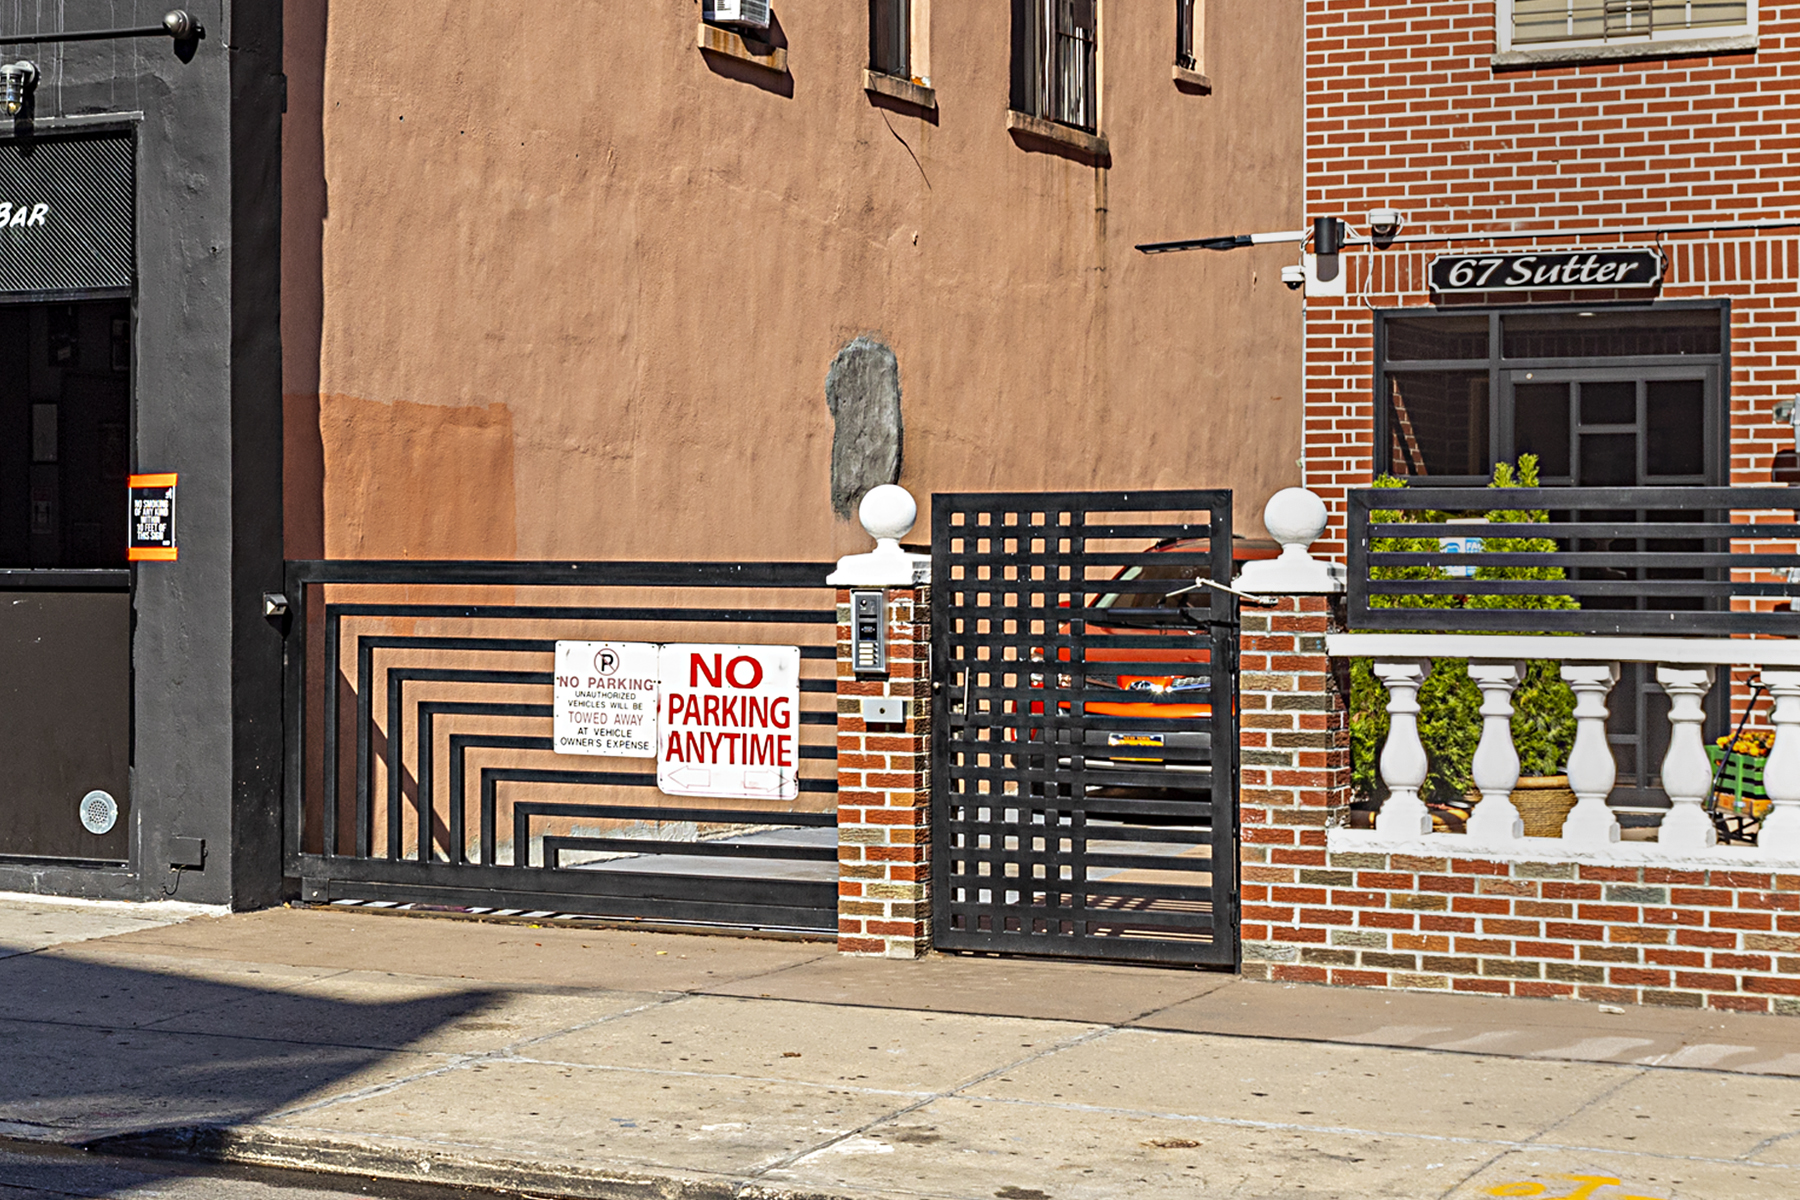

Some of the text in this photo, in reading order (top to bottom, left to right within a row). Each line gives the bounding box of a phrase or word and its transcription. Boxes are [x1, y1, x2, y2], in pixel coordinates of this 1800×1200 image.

[1449, 254, 1639, 287] 67 Sutter
[690, 653, 763, 689] NO
[559, 676, 654, 691] NO PARKING
[575, 691, 636, 700] UNAUTHORIZED
[568, 700, 643, 710] VEHICLES WILL BE
[668, 693, 790, 730] PARKING
[568, 711, 643, 726] TOWED AWAY
[577, 727, 632, 738] AT VEHICLE
[560, 736, 650, 751] OWNER'S EXPENSE
[665, 731, 792, 767] ANYTIME
